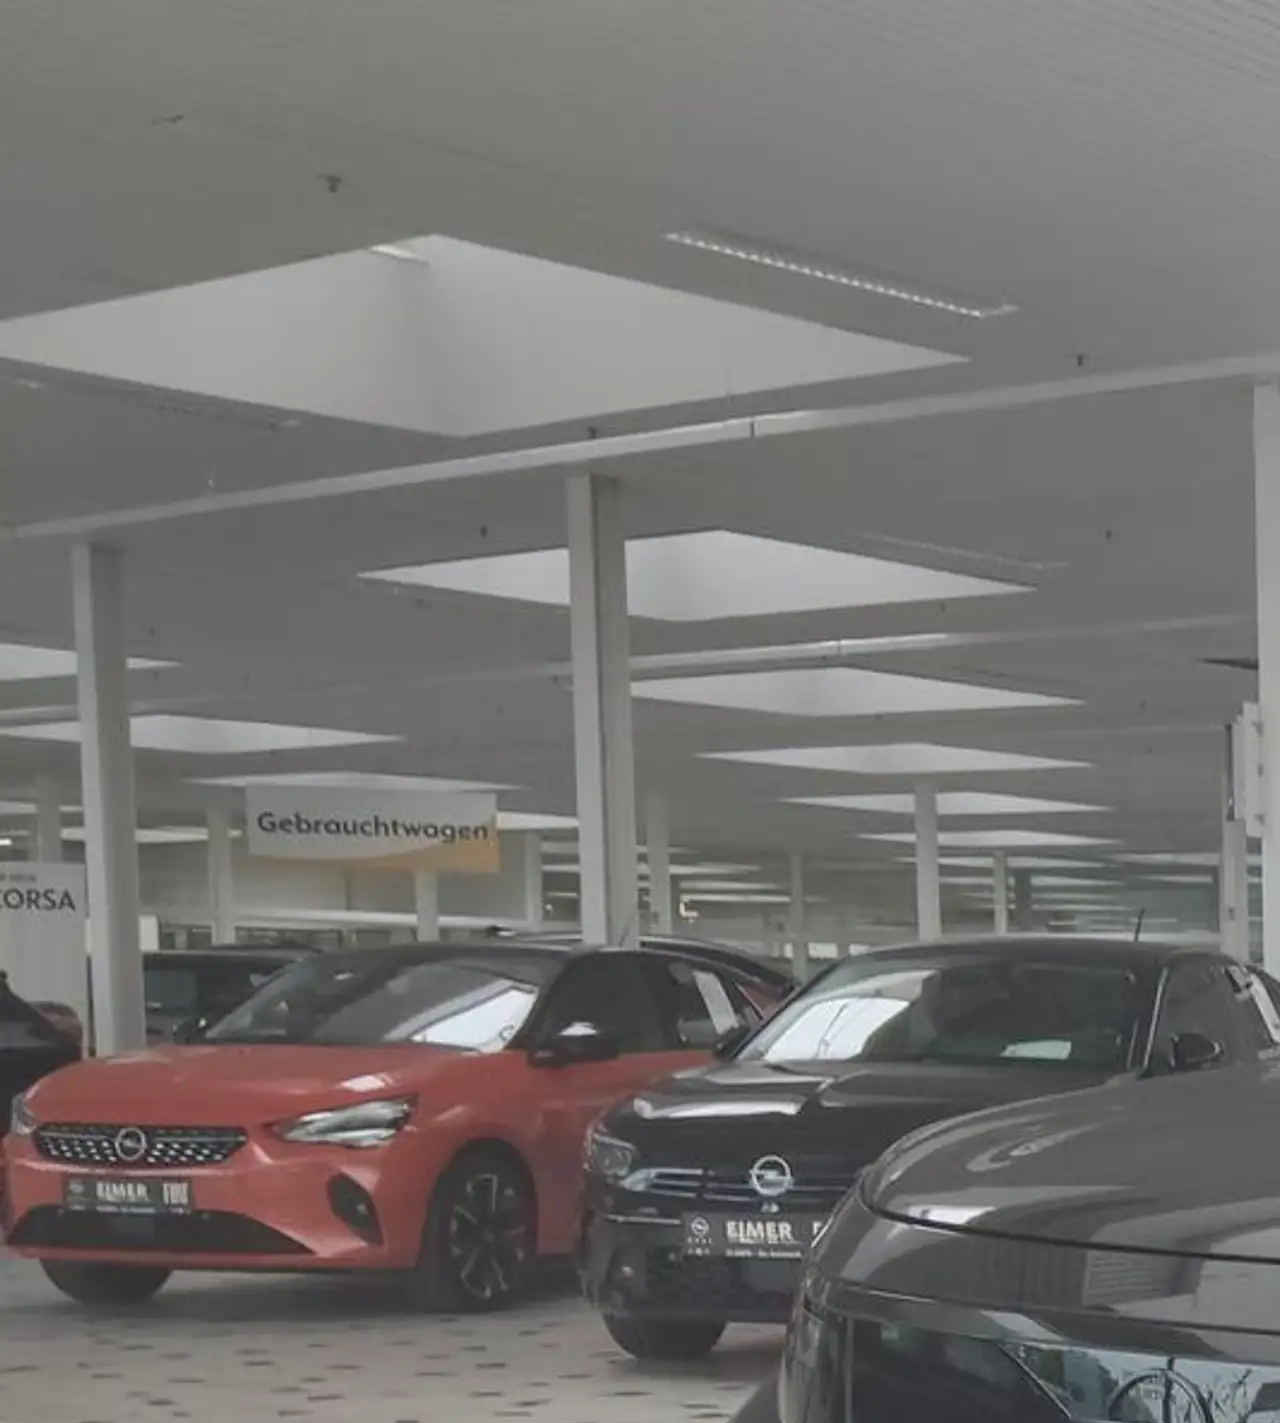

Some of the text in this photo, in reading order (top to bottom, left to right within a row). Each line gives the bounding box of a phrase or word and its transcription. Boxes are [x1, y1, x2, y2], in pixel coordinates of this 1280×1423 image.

[256, 811, 490, 843] Gebrauchtwagen
[0, 888, 77, 912] ORSA
[726, 1219, 793, 1243] ELMER
